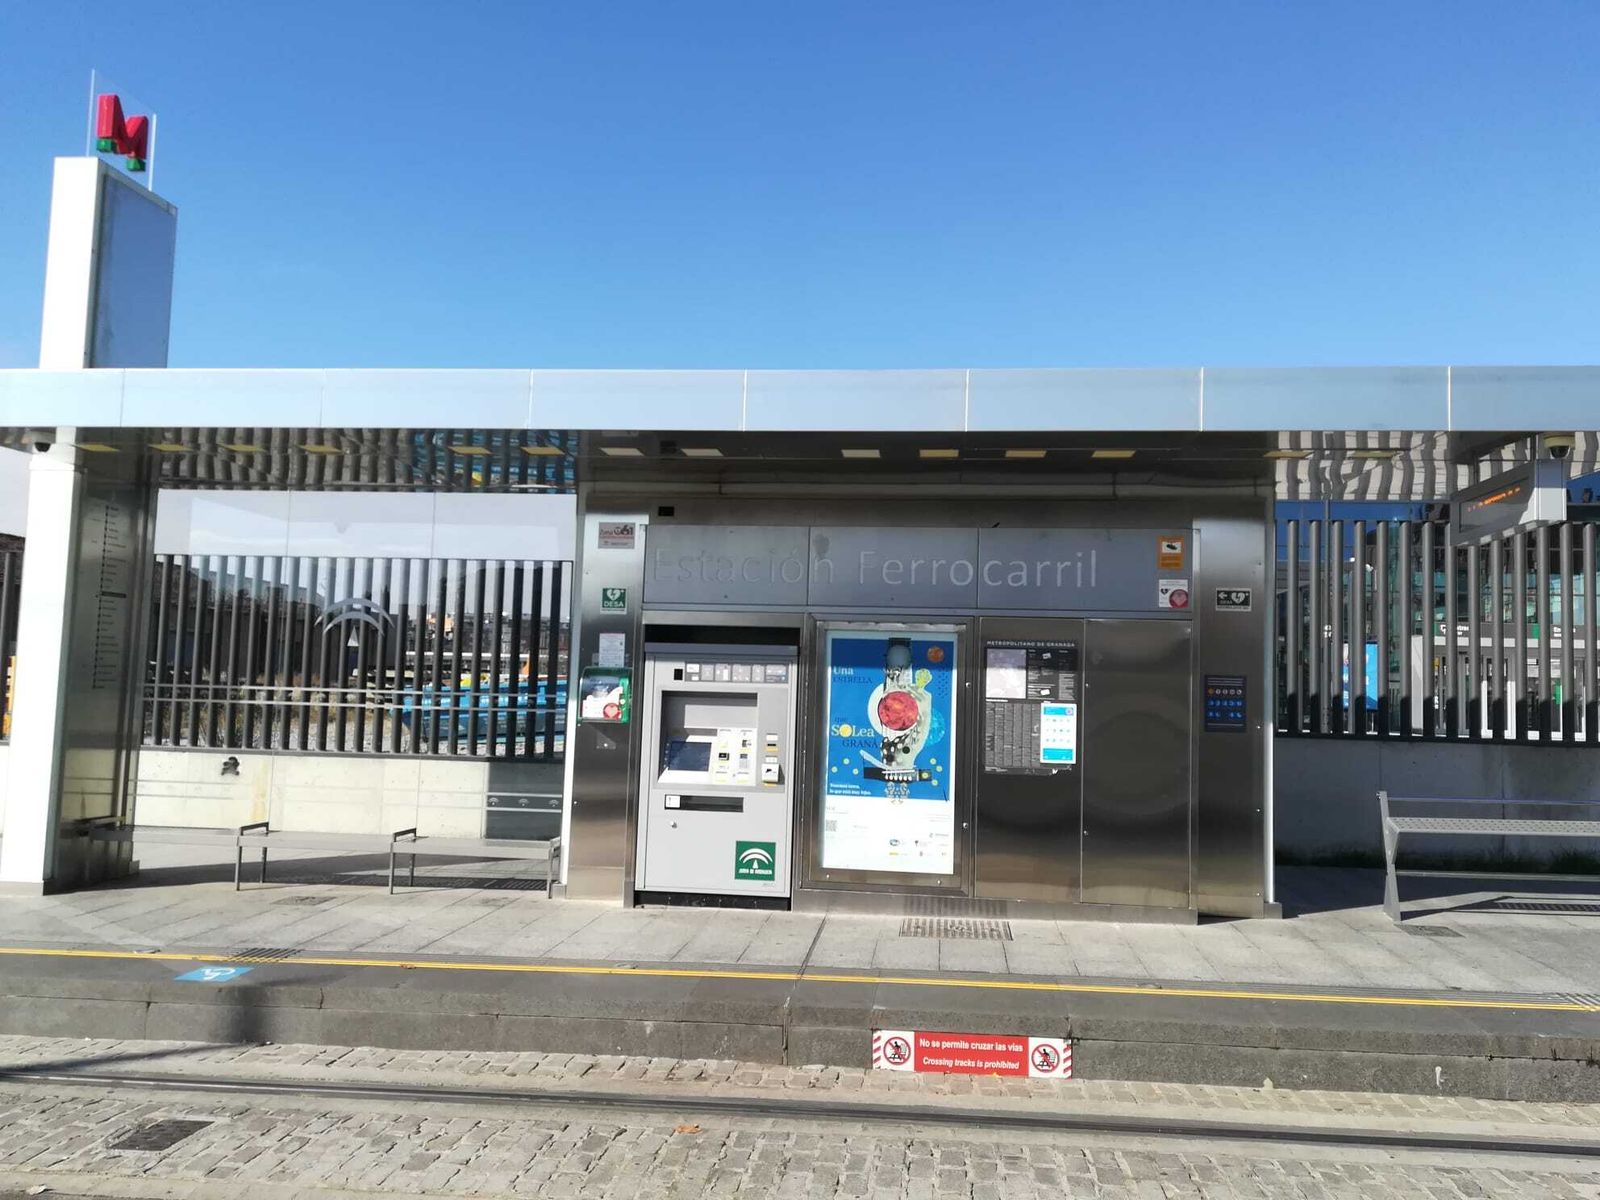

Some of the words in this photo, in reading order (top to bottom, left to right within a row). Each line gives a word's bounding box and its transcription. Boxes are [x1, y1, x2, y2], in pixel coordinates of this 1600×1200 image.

[653, 546, 834, 585] Estación
[859, 549, 1097, 589] Ferrocarril
[832, 666, 854, 675] Una
[832, 675, 873, 684] ESTRELLA
[919, 1038, 930, 1047] No
[931, 1040, 940, 1048] se
[941, 1039, 969, 1051] permite
[971, 1042, 994, 1051] cruzar
[995, 1042, 1006, 1051] las
[923, 1057, 953, 1068] Crossing
[954, 1058, 976, 1067] tracks
[977, 1059, 983, 1068] is
[984, 1059, 1020, 1070] prohibited
